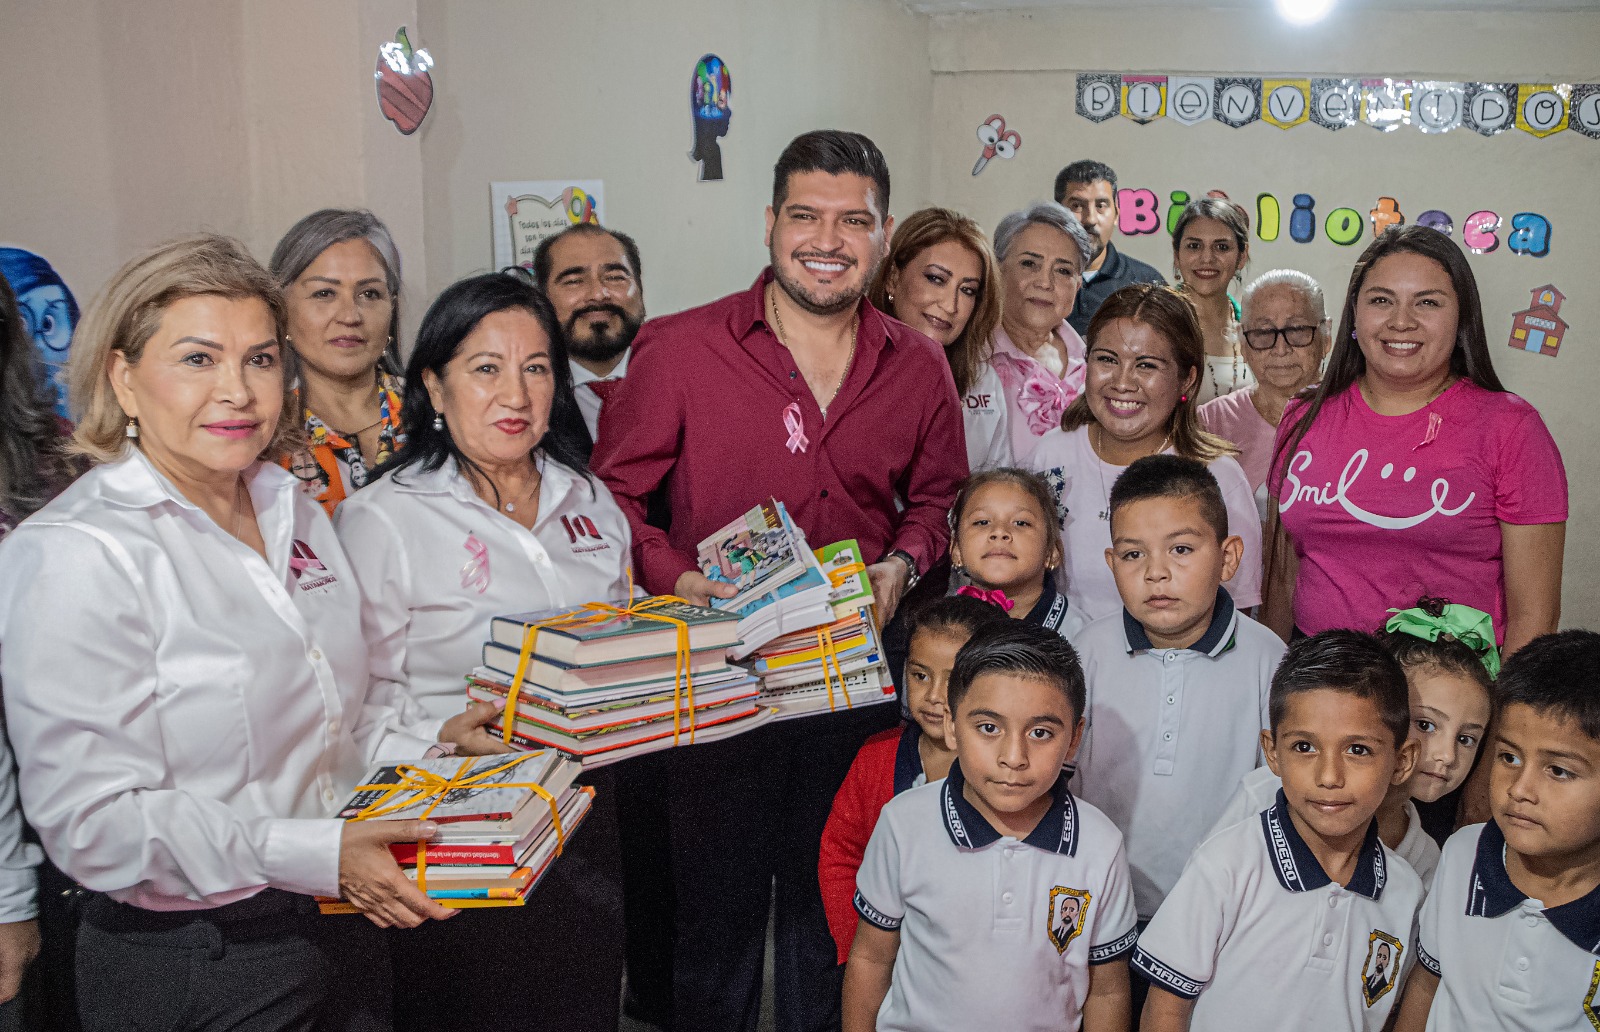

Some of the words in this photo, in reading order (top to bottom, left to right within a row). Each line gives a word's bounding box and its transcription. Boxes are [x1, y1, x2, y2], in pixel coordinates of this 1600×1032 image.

[1117, 188, 1552, 258] Bilioteca
[966, 394, 991, 408] DIF
[1280, 448, 1475, 529] Smile
[1270, 818, 1297, 881] MADERO
